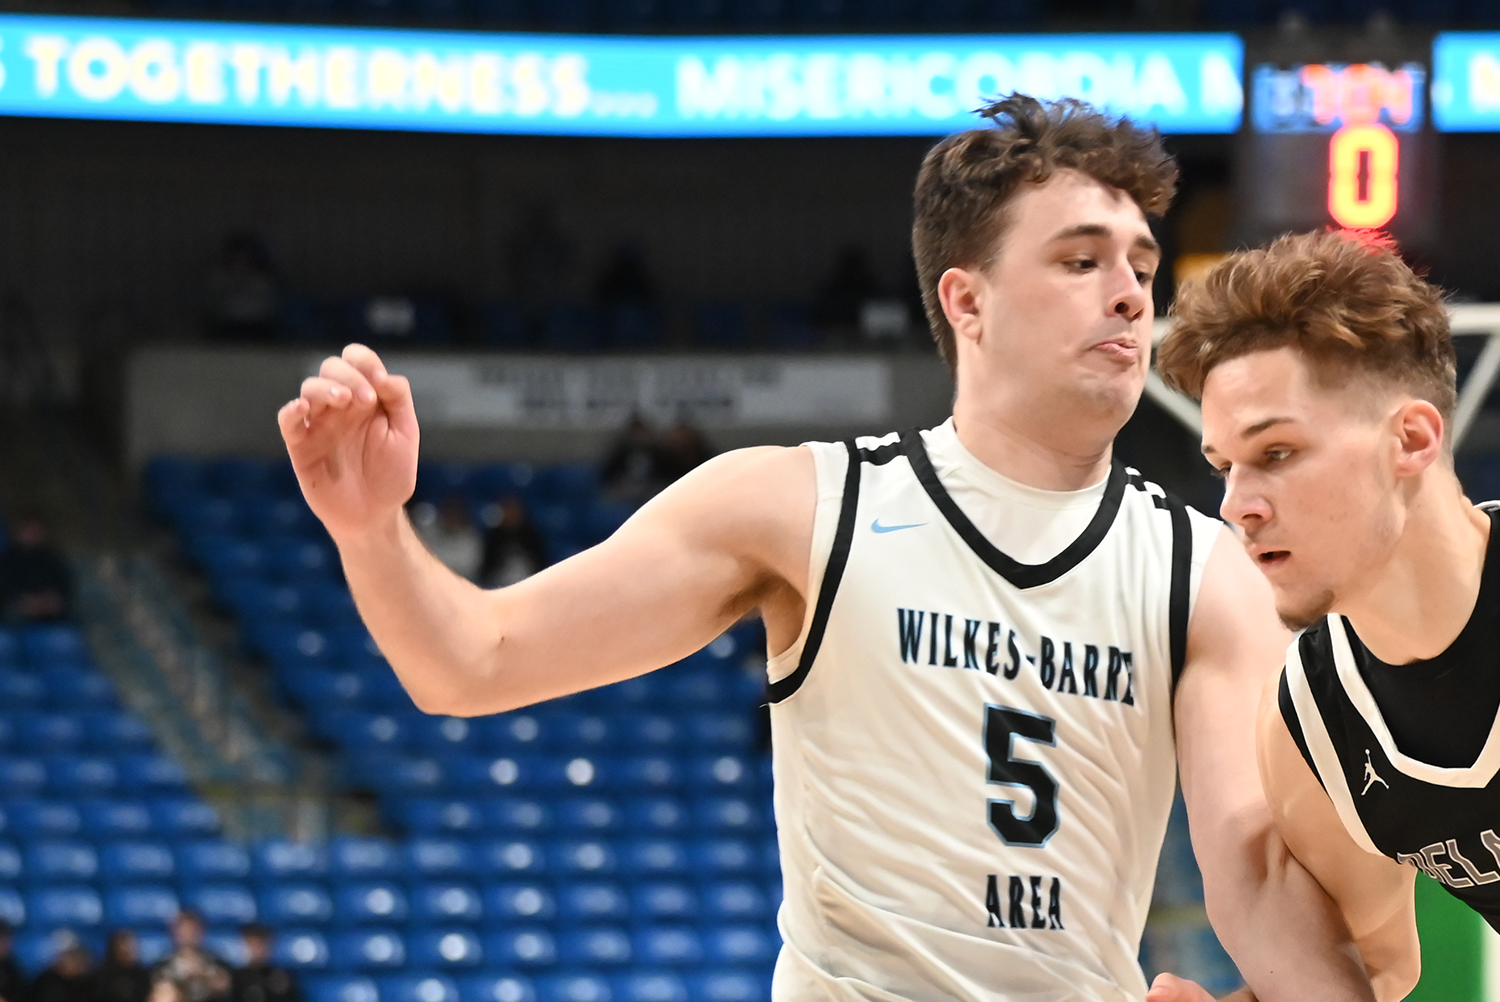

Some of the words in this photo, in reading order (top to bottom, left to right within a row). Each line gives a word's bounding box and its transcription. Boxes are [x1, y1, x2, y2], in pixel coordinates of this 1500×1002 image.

[676, 52, 1186, 119] MISERICORDIA
[1327, 122, 1399, 229] 0
[983, 702, 1060, 849] 5
[984, 873, 1065, 931] AREA
